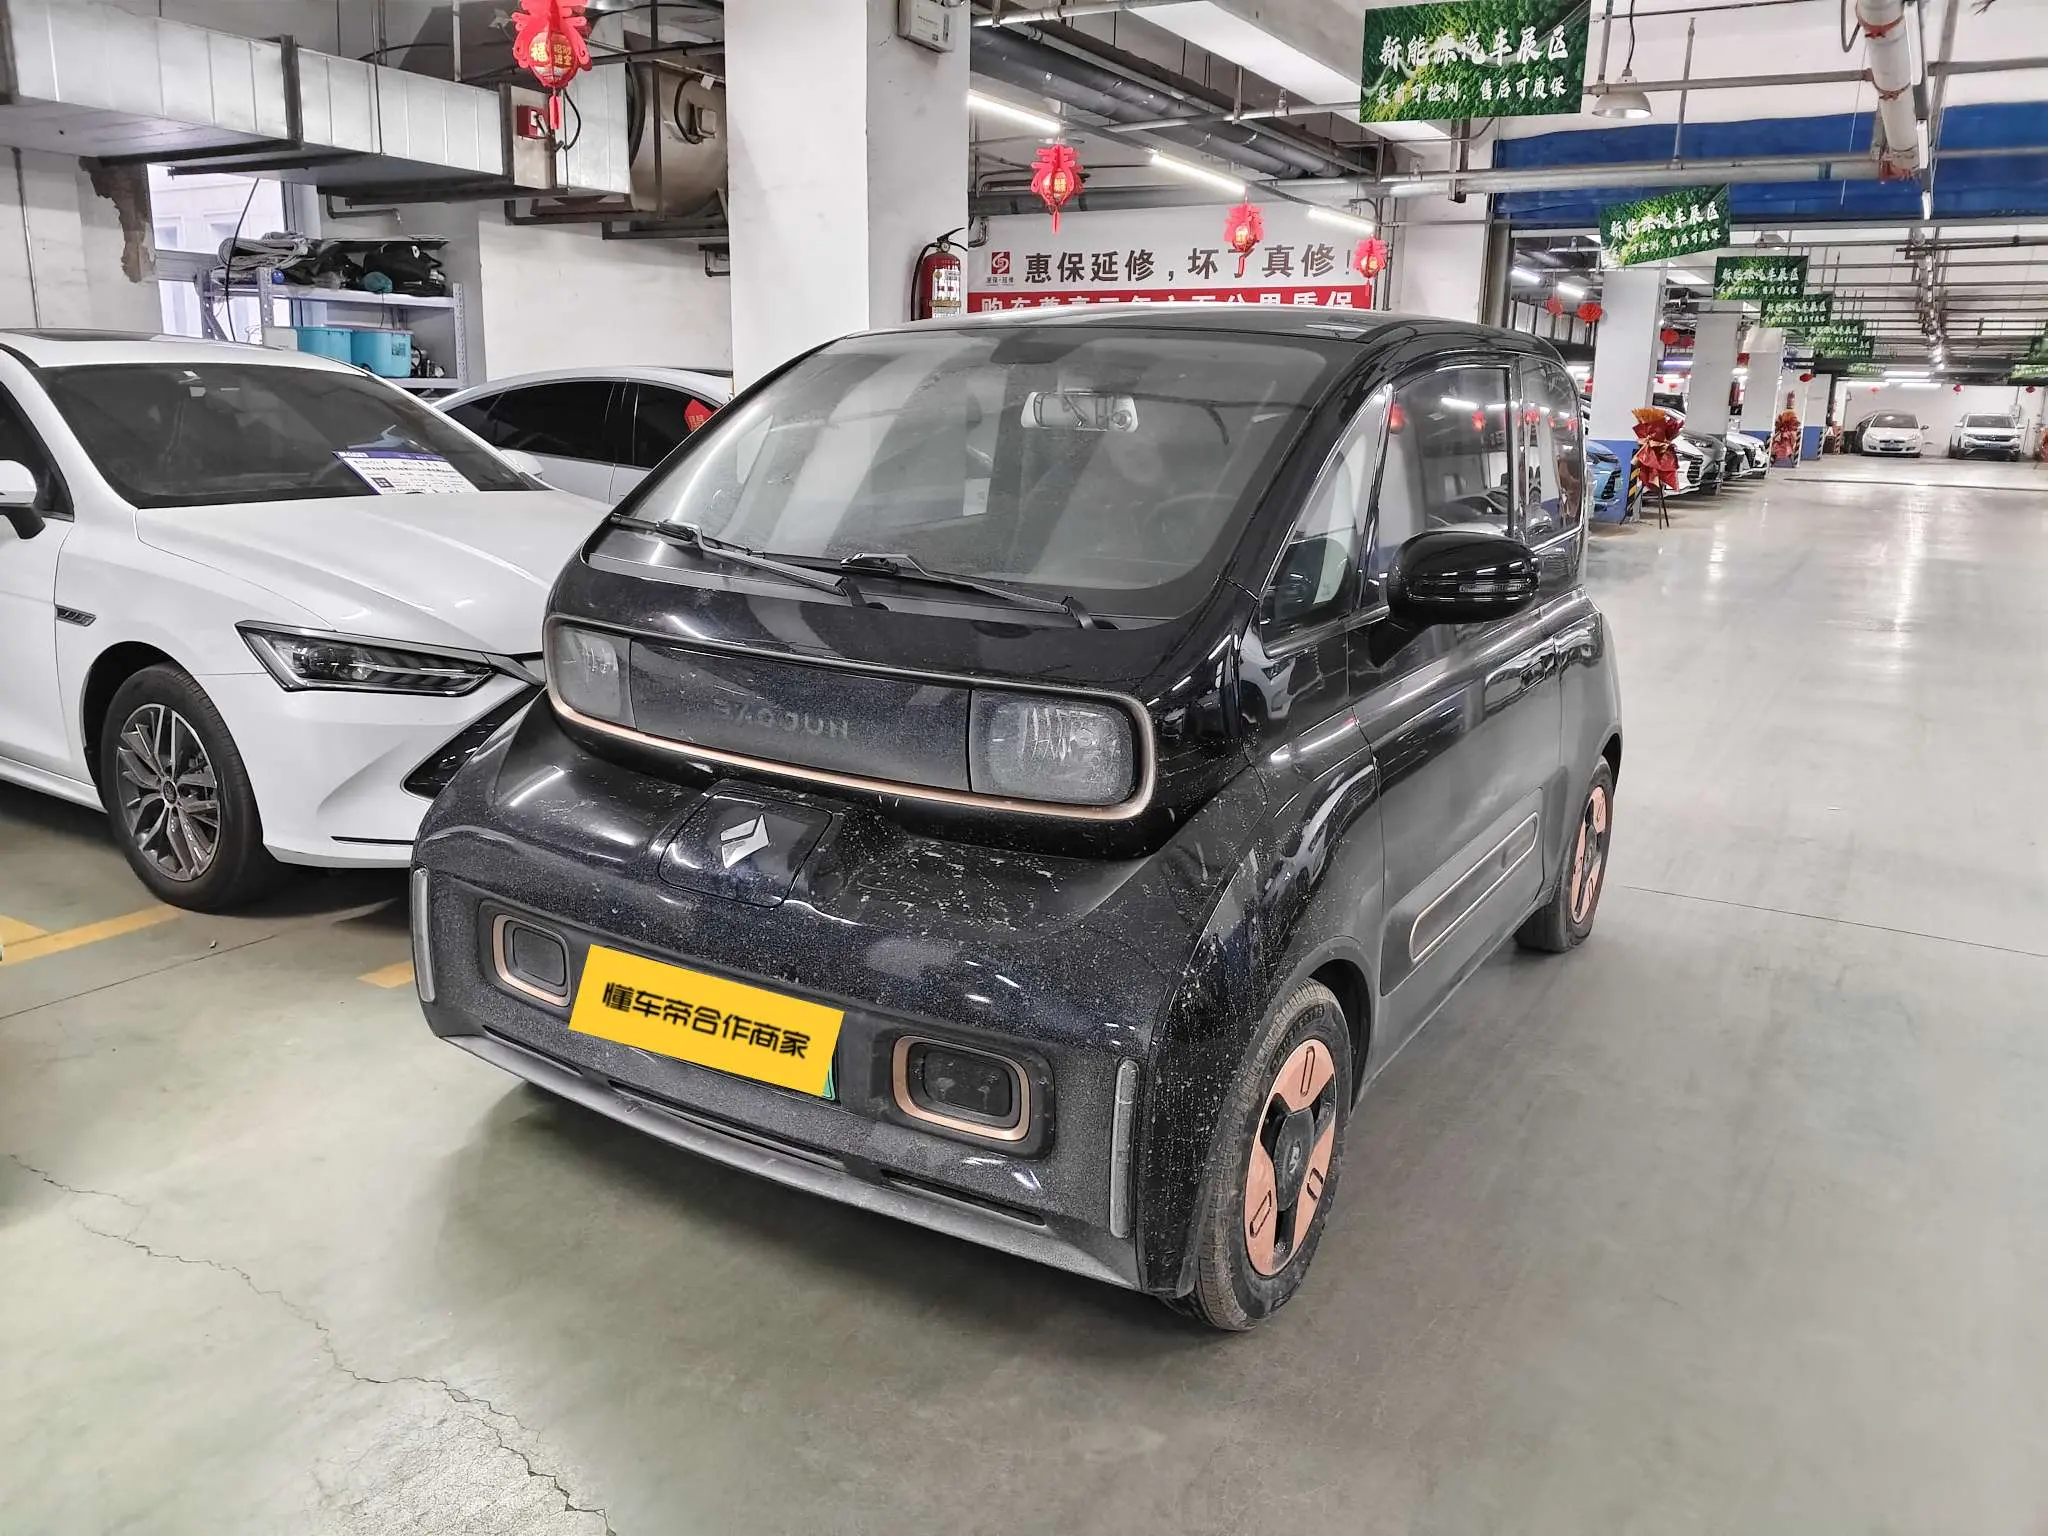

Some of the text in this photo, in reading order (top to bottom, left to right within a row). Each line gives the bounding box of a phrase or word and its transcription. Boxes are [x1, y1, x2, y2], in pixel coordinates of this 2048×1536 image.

[1379, 25, 1568, 72] 新能源汽车展区
